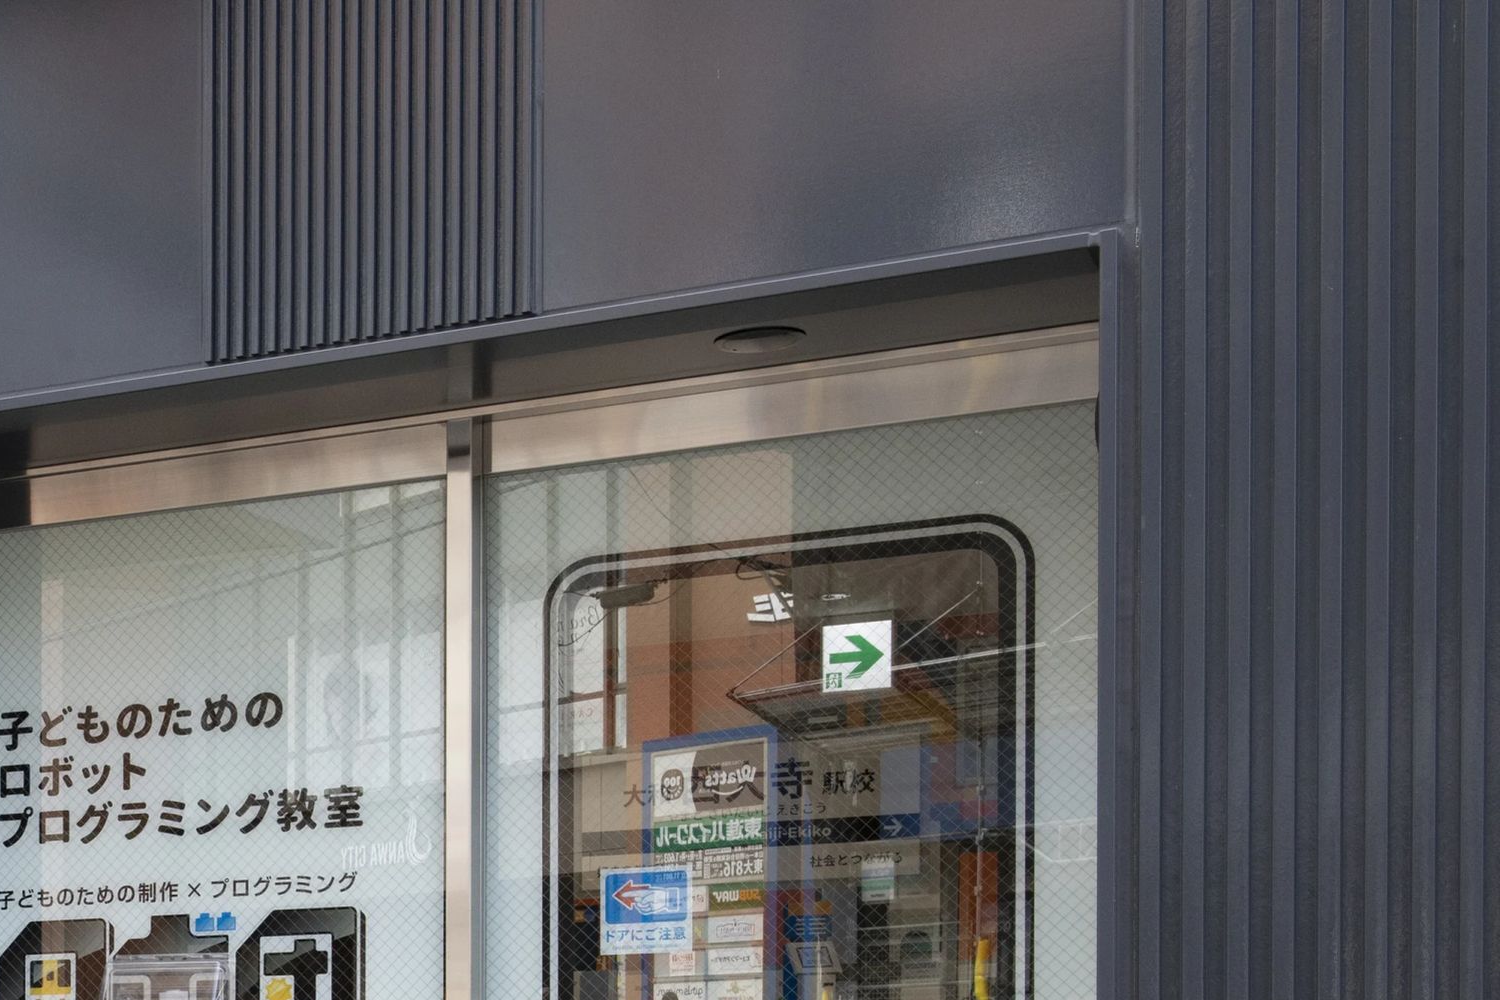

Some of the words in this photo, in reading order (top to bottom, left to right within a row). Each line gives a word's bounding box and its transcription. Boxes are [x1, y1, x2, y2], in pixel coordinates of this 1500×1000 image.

[0, 752, 147, 798] ロボット
[210, 871, 358, 898] プログラミング
[605, 927, 686, 943] ドアにご注意
